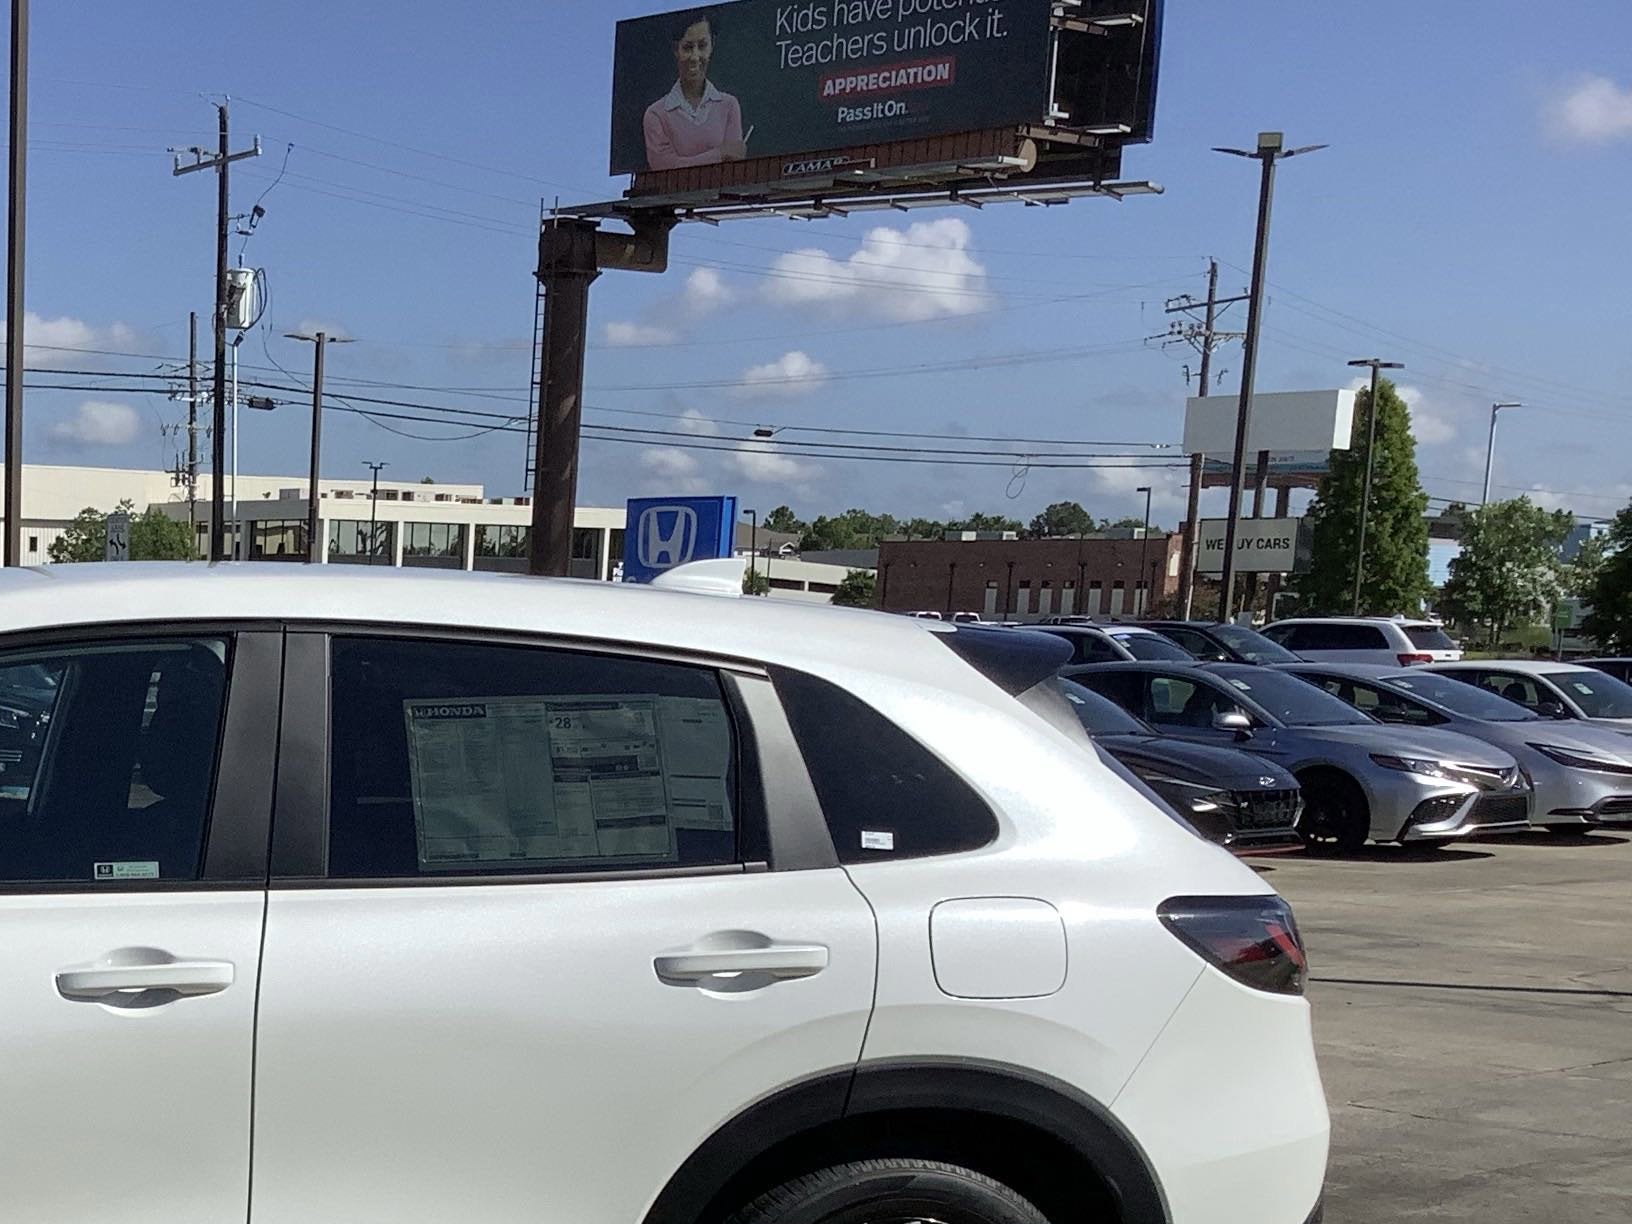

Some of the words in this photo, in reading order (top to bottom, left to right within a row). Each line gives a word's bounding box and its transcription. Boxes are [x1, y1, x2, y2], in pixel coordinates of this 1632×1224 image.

[775, 4, 828, 36] Kids
[832, 0, 892, 27] have
[775, 30, 888, 70] Teachers
[893, 12, 981, 53] unlock
[985, 8, 1009, 39] it.
[822, 63, 951, 97] APPRECIATION
[1206, 539, 1225, 550] WE
[1256, 538, 1290, 550] CARS
[428, 706, 485, 717] HONDA
[555, 717, 572, 729] 28
